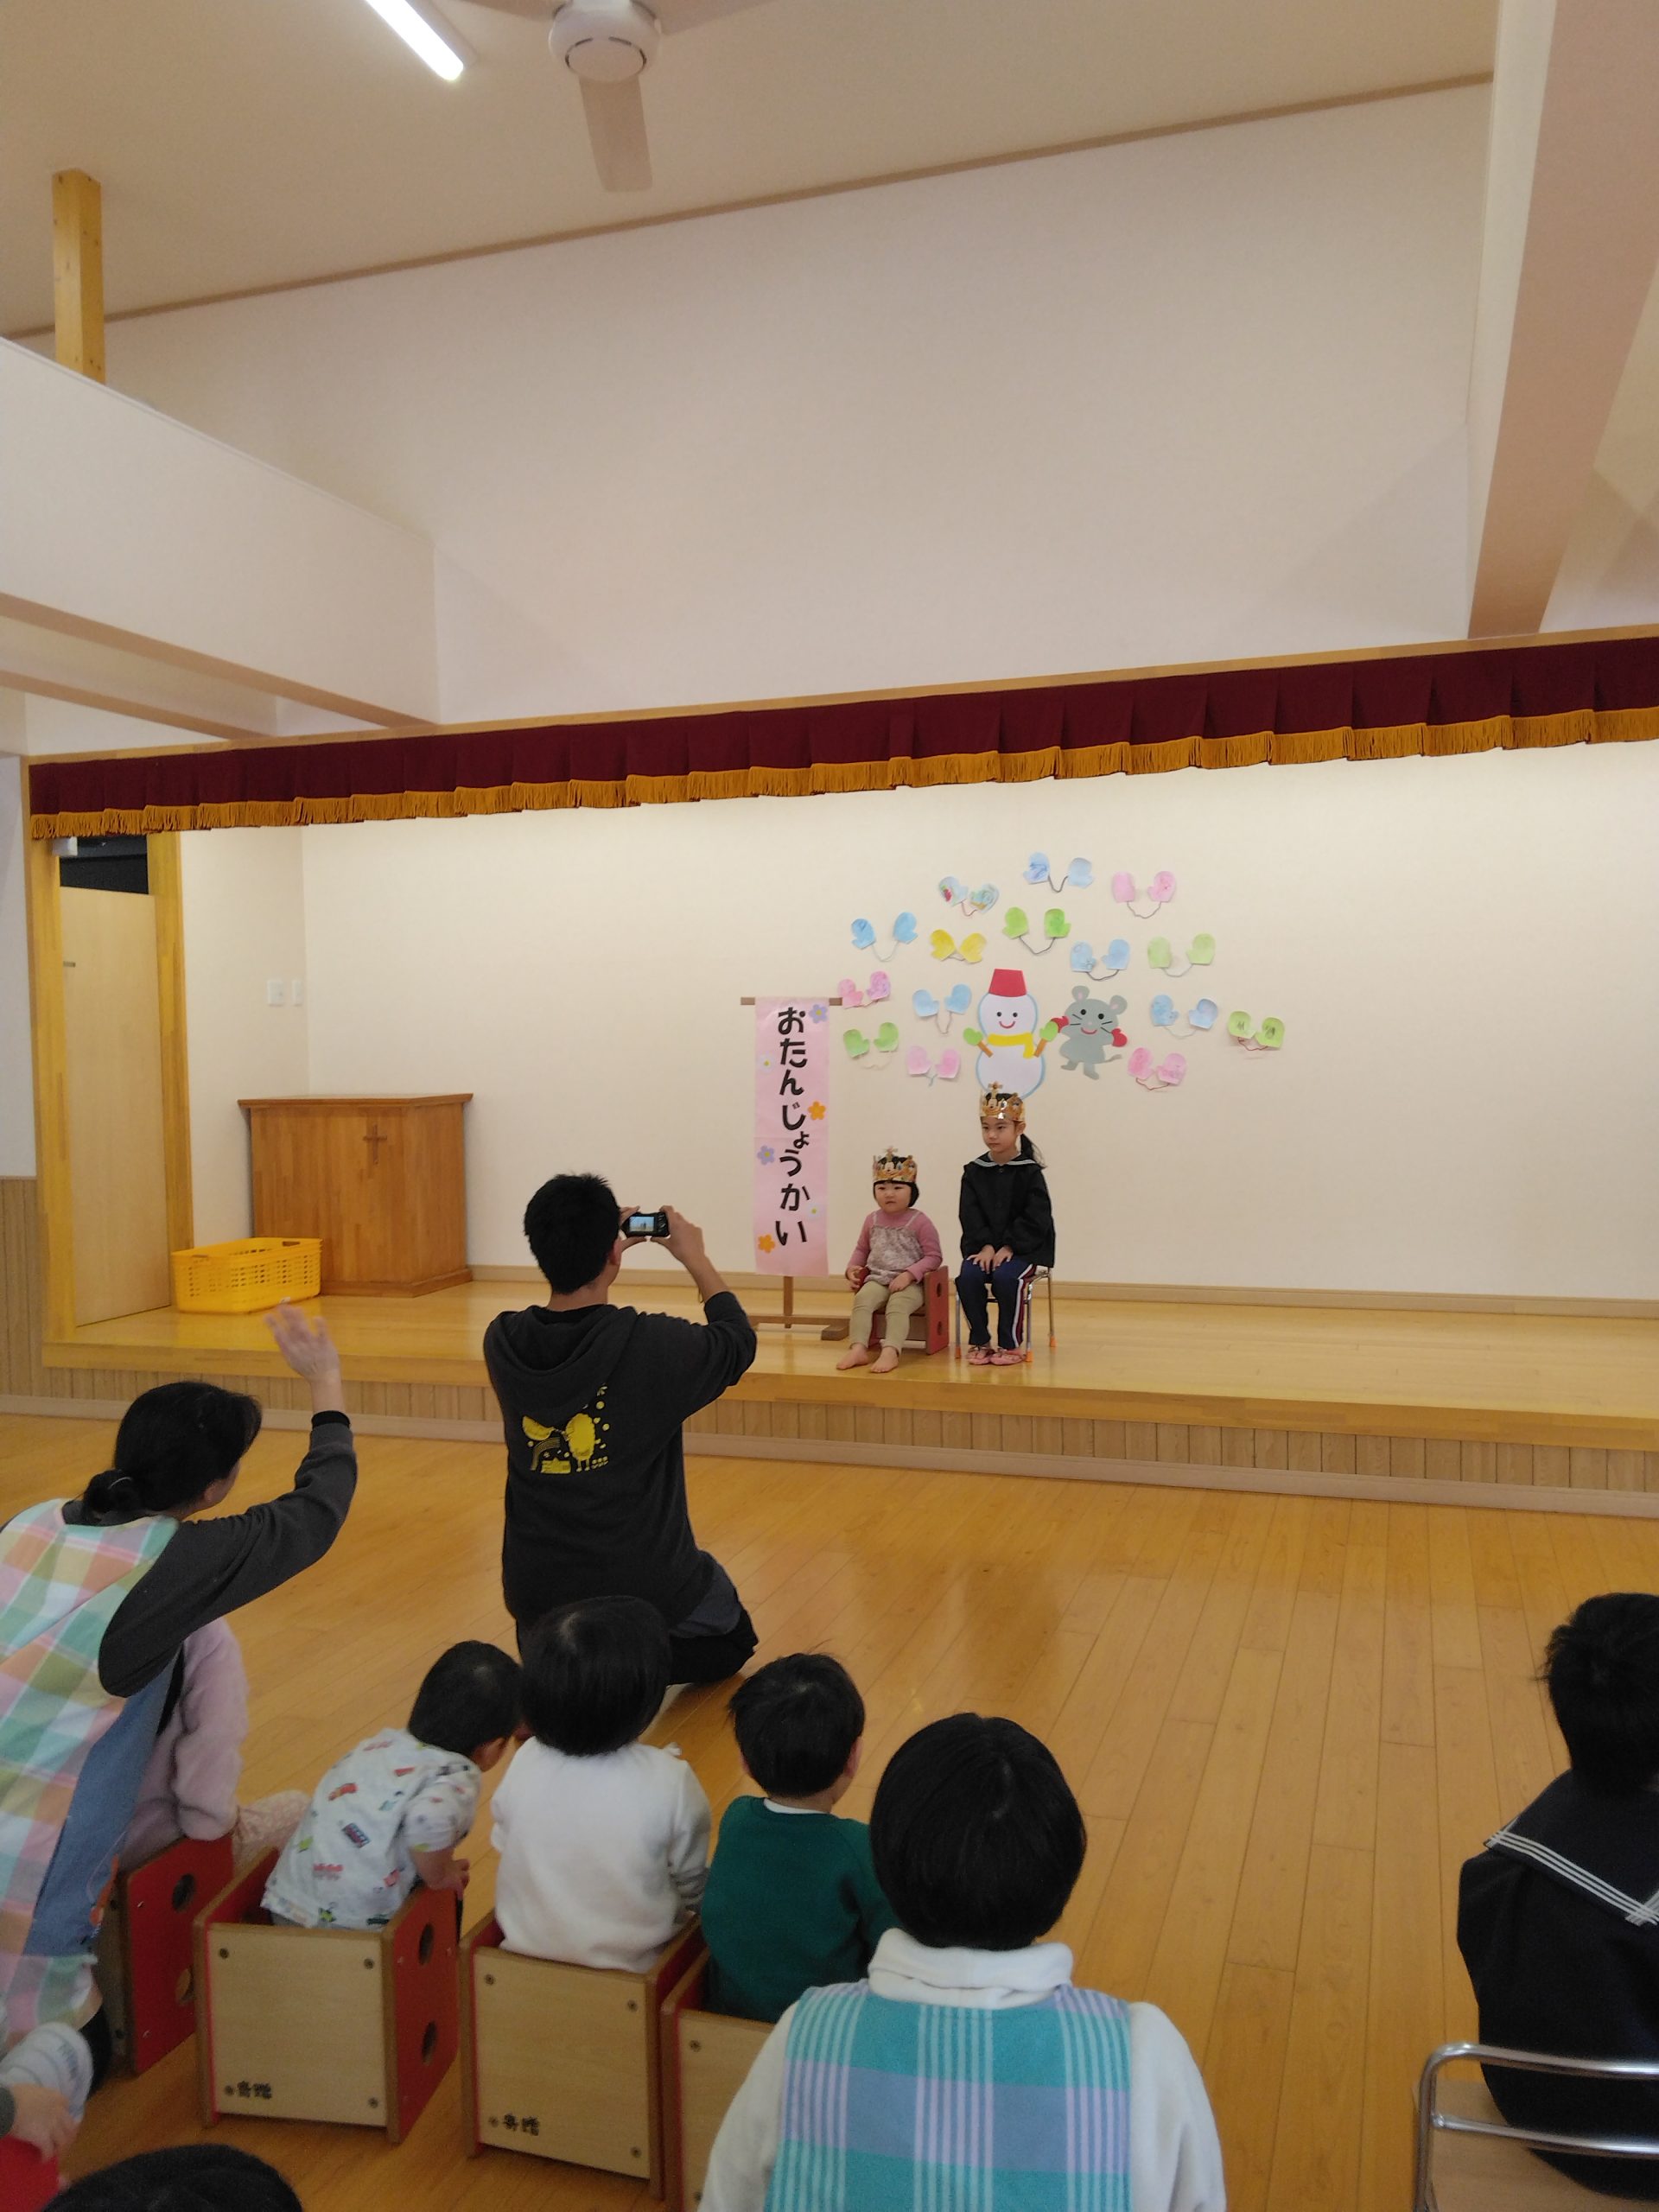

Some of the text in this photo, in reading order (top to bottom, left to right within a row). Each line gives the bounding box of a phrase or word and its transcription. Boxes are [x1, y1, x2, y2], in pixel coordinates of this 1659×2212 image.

[775, 1006, 811, 1247] おたんじょうかい
